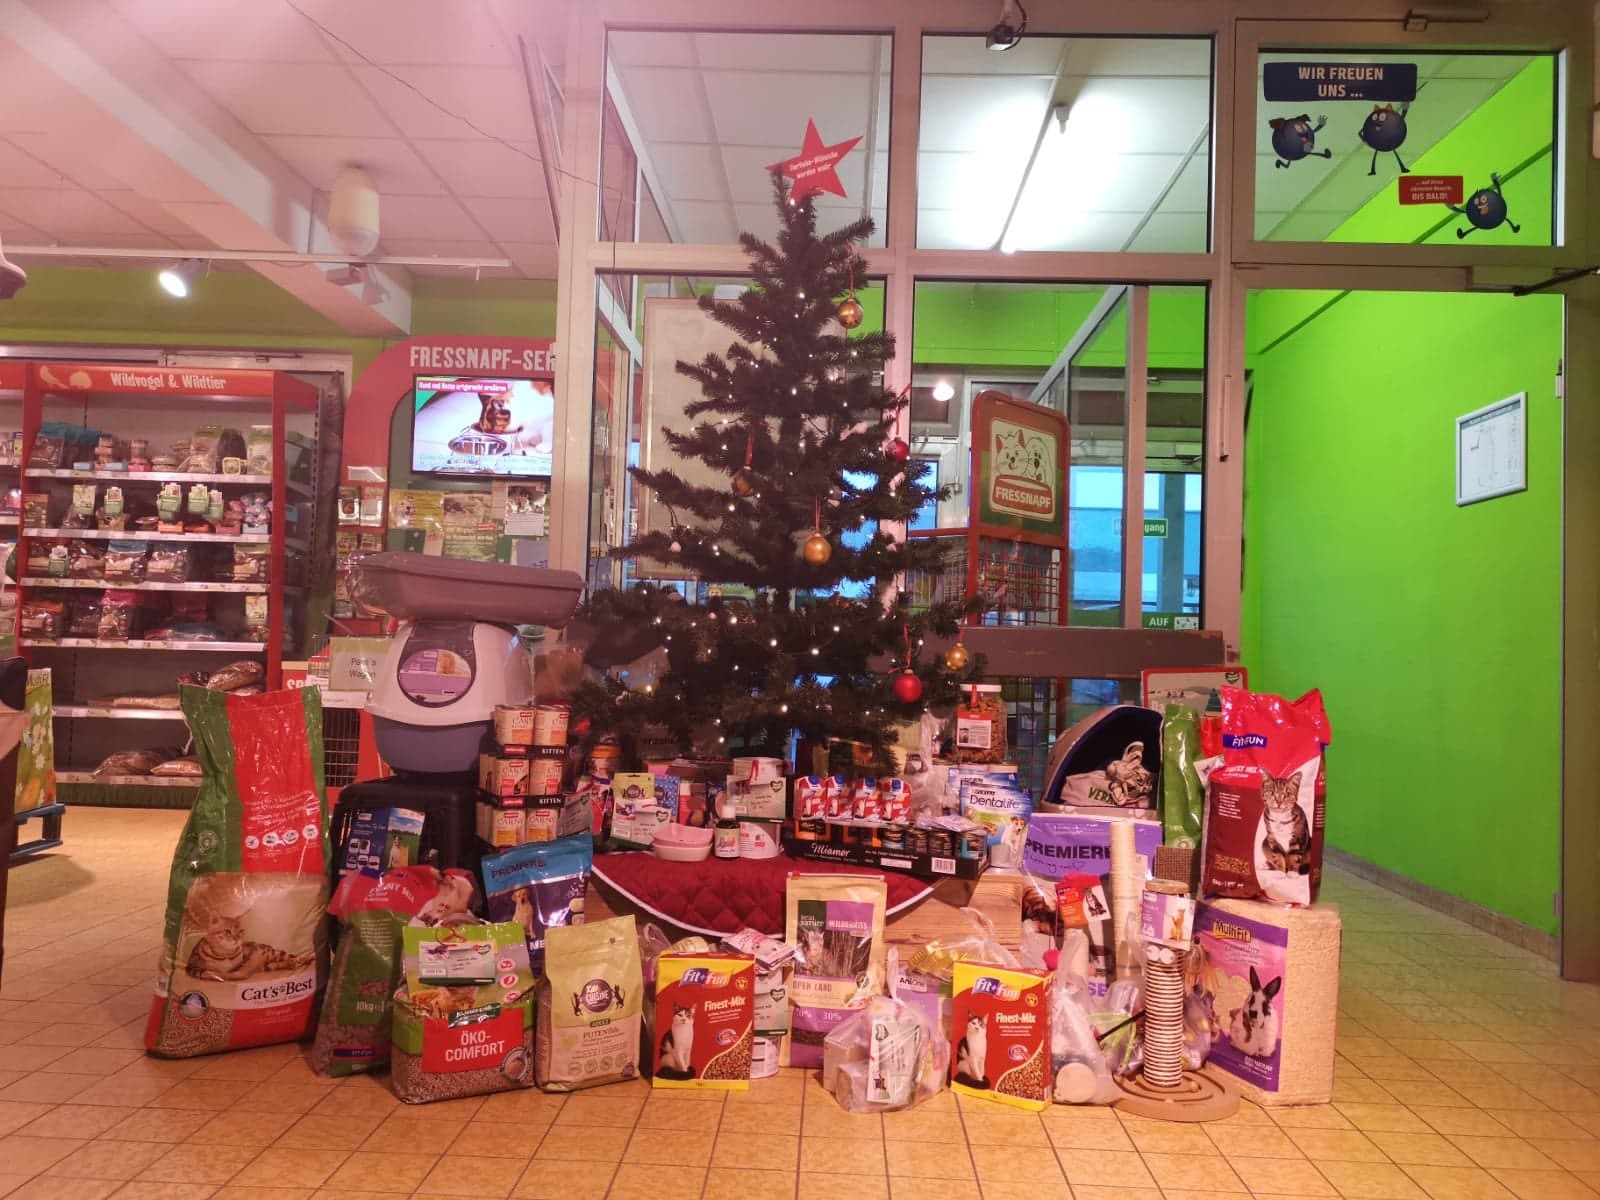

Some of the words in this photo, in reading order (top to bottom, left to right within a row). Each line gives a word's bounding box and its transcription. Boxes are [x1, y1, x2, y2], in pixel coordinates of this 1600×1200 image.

[1298, 67, 1325, 80] WIR
[1329, 67, 1383, 80] FREUEN
[1318, 84, 1346, 97] UNS
[1412, 192, 1425, 200] BIS
[110, 372, 164, 391] Wildvogel
[168, 374, 179, 388] &
[182, 374, 226, 389] Wildtier
[995, 485, 1051, 508] FRESSNAPF
[1149, 616, 1168, 627] AUF
[811, 842, 851, 857] Miamor
[241, 985, 279, 1001] Cat's
[286, 978, 313, 996] Best
[793, 980, 811, 990] OPEN
[814, 983, 832, 993] LAND
[704, 996, 746, 1012] Finest-Mix
[995, 1013, 1037, 1024] Finest-Mix
[460, 1030, 492, 1046] ÖKO-
[445, 1041, 505, 1062] COMFORT
